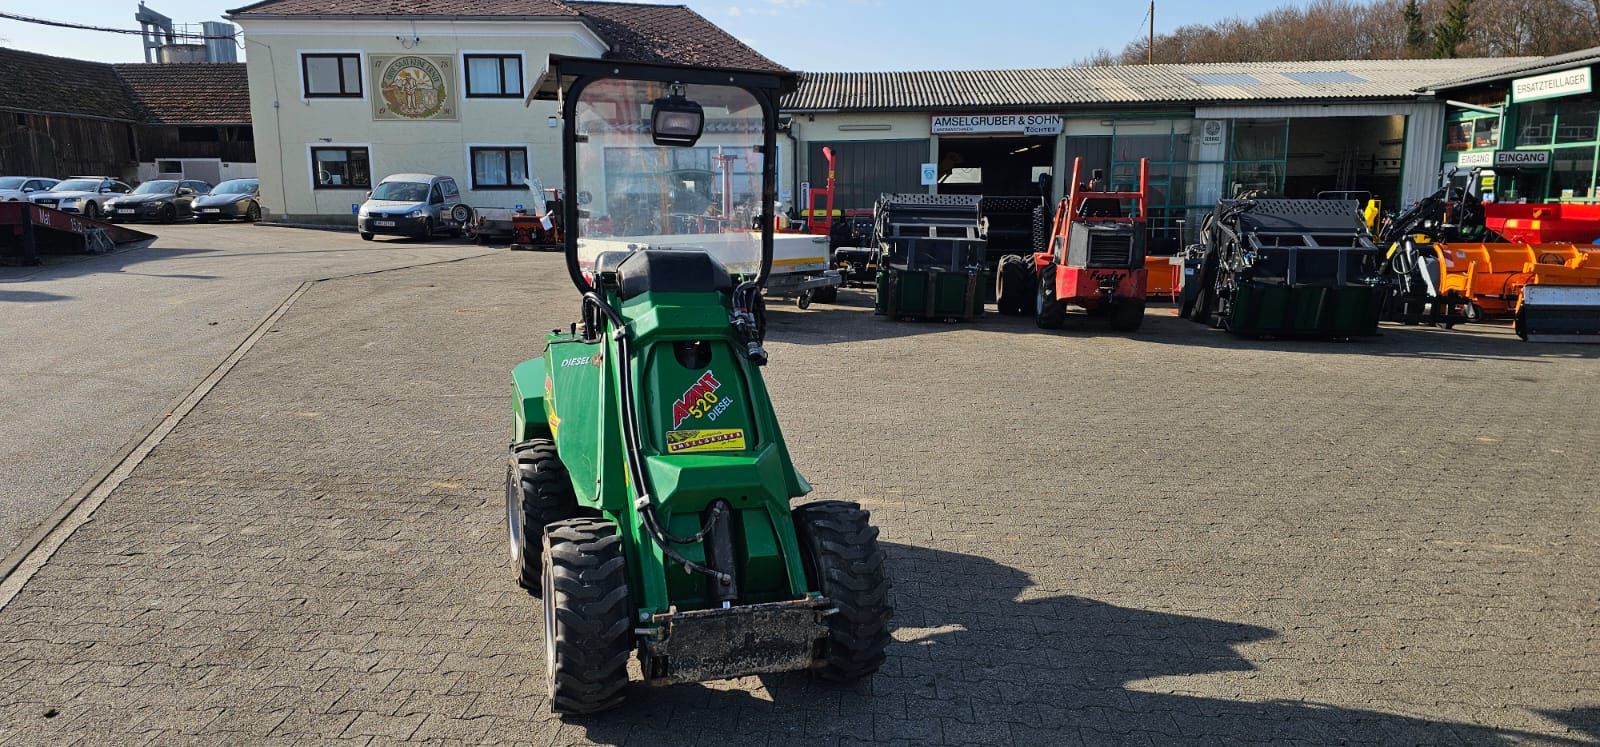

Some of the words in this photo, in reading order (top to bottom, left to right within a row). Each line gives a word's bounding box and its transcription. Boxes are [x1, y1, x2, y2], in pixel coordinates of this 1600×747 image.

[1517, 74, 1585, 94] ERSATZTEILLAGER
[934, 116, 1015, 127] AMSELGRUBER
[1018, 116, 1025, 125] &
[1027, 115, 1060, 125] SOHN
[1461, 154, 1490, 164] EINGANG
[1498, 153, 1545, 162] EINGANG
[561, 356, 590, 368] DIESEL
[673, 370, 721, 430] AVANT
[688, 391, 718, 419] 520
[707, 396, 733, 421] DIESEL
